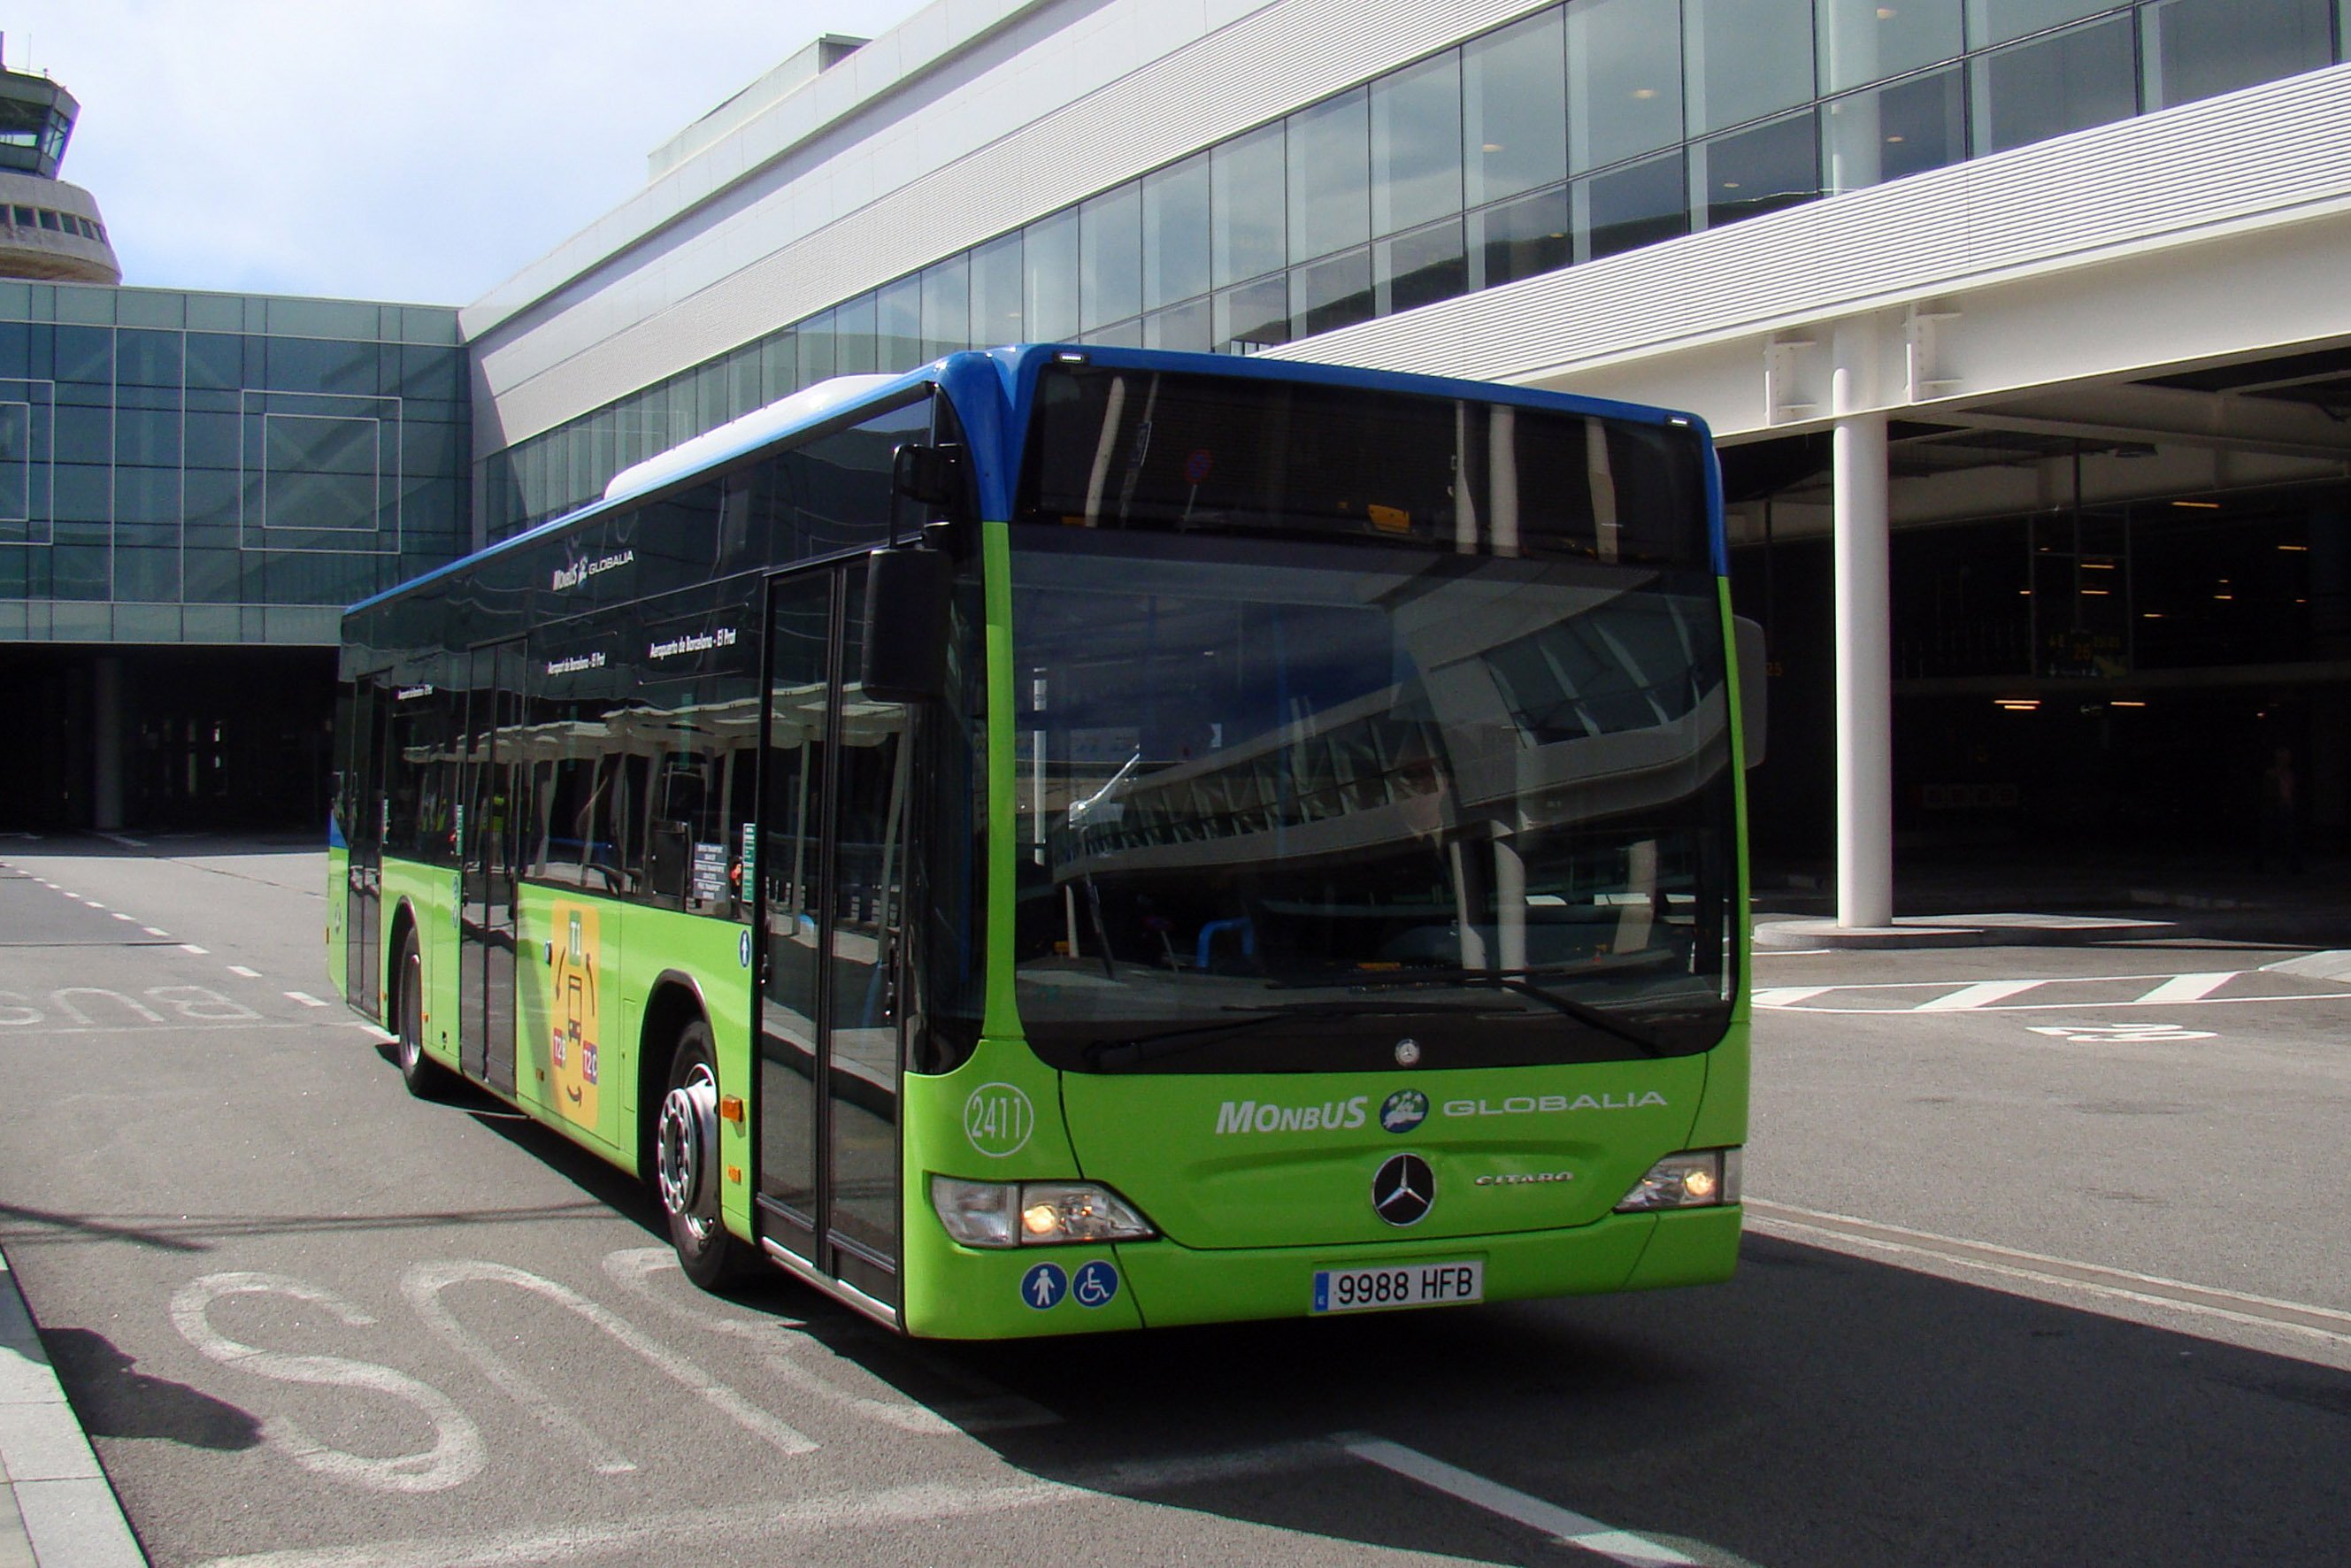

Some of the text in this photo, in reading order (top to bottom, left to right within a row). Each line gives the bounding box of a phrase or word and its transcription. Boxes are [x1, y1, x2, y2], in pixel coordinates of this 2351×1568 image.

[588, 550, 634, 575] GLOBALIA
[583, 1047, 596, 1076] T2C
[972, 1095, 1020, 1139] 2411
[1443, 1091, 1667, 1116] GLOBALIA
[1476, 1172, 1574, 1186] CITARO
[1338, 1272, 1409, 1304] 9988
[1421, 1267, 1473, 1299] HFB
